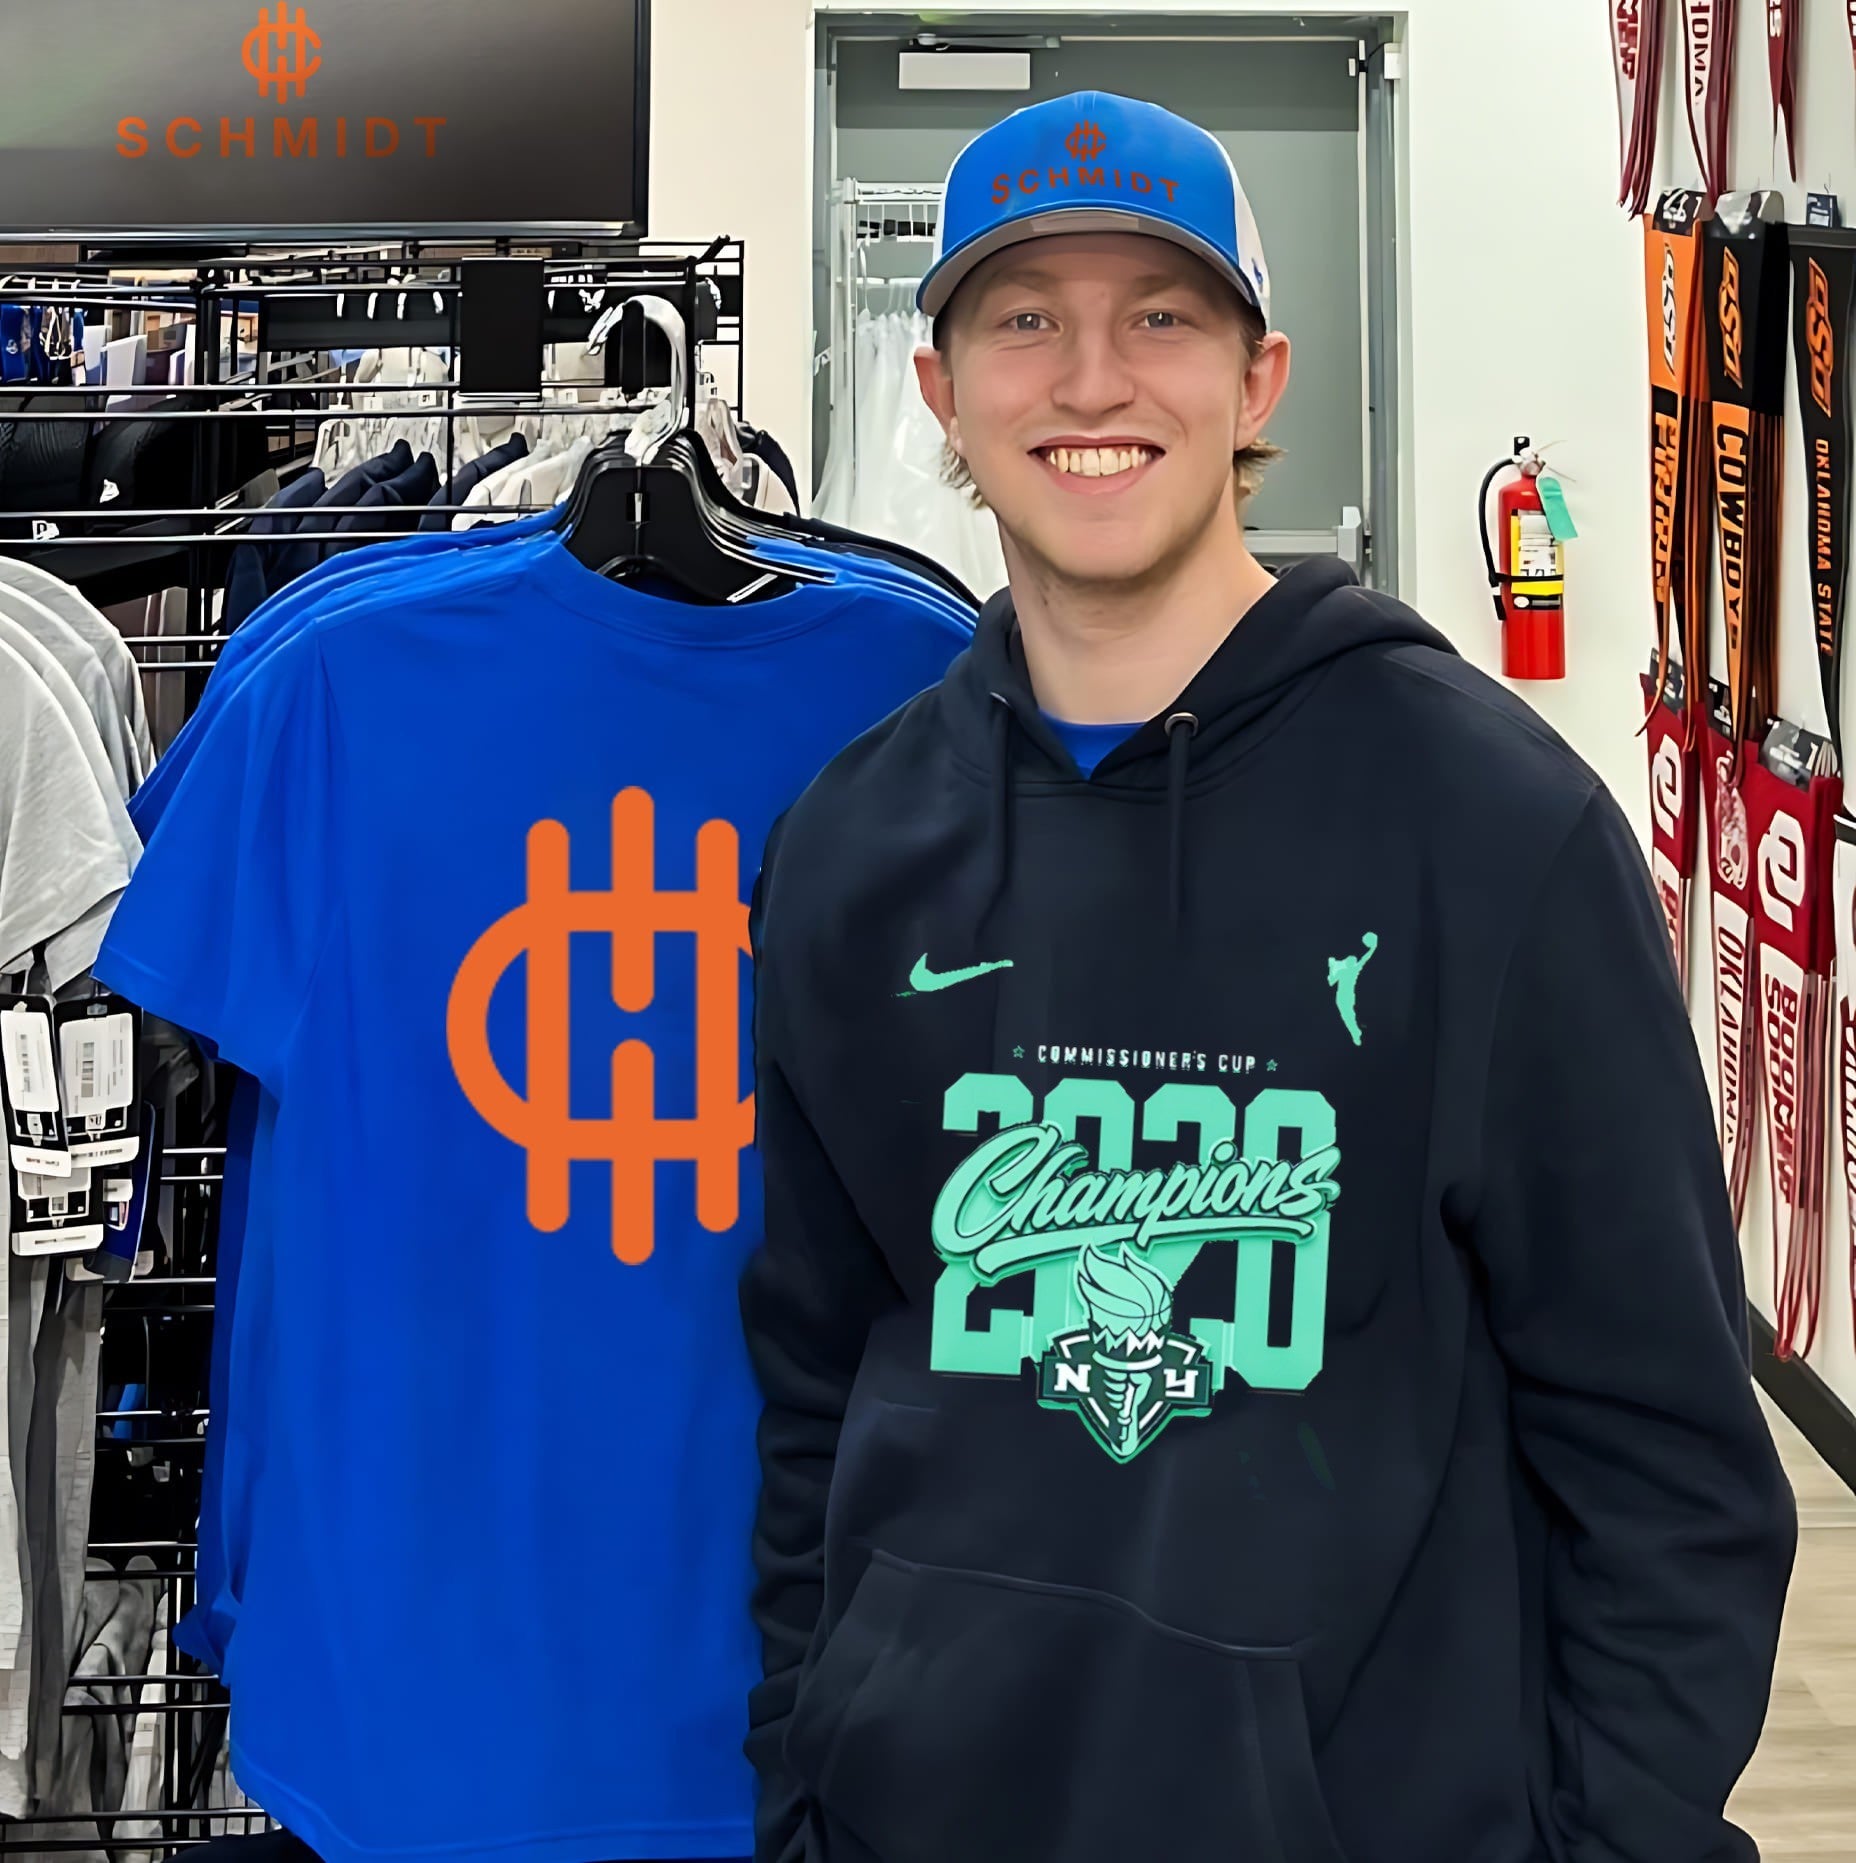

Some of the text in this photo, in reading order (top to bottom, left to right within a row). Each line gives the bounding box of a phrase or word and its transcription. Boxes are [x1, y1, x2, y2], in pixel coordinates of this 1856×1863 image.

[116, 117, 447, 159] SCHMIDT
[992, 167, 1179, 205] SCHMIDT
[1717, 925, 1744, 1144] OKLAHOMA
[1038, 1045, 1256, 1074] COMMISSIONER'S CUP
[932, 1121, 1341, 1256] Champions
